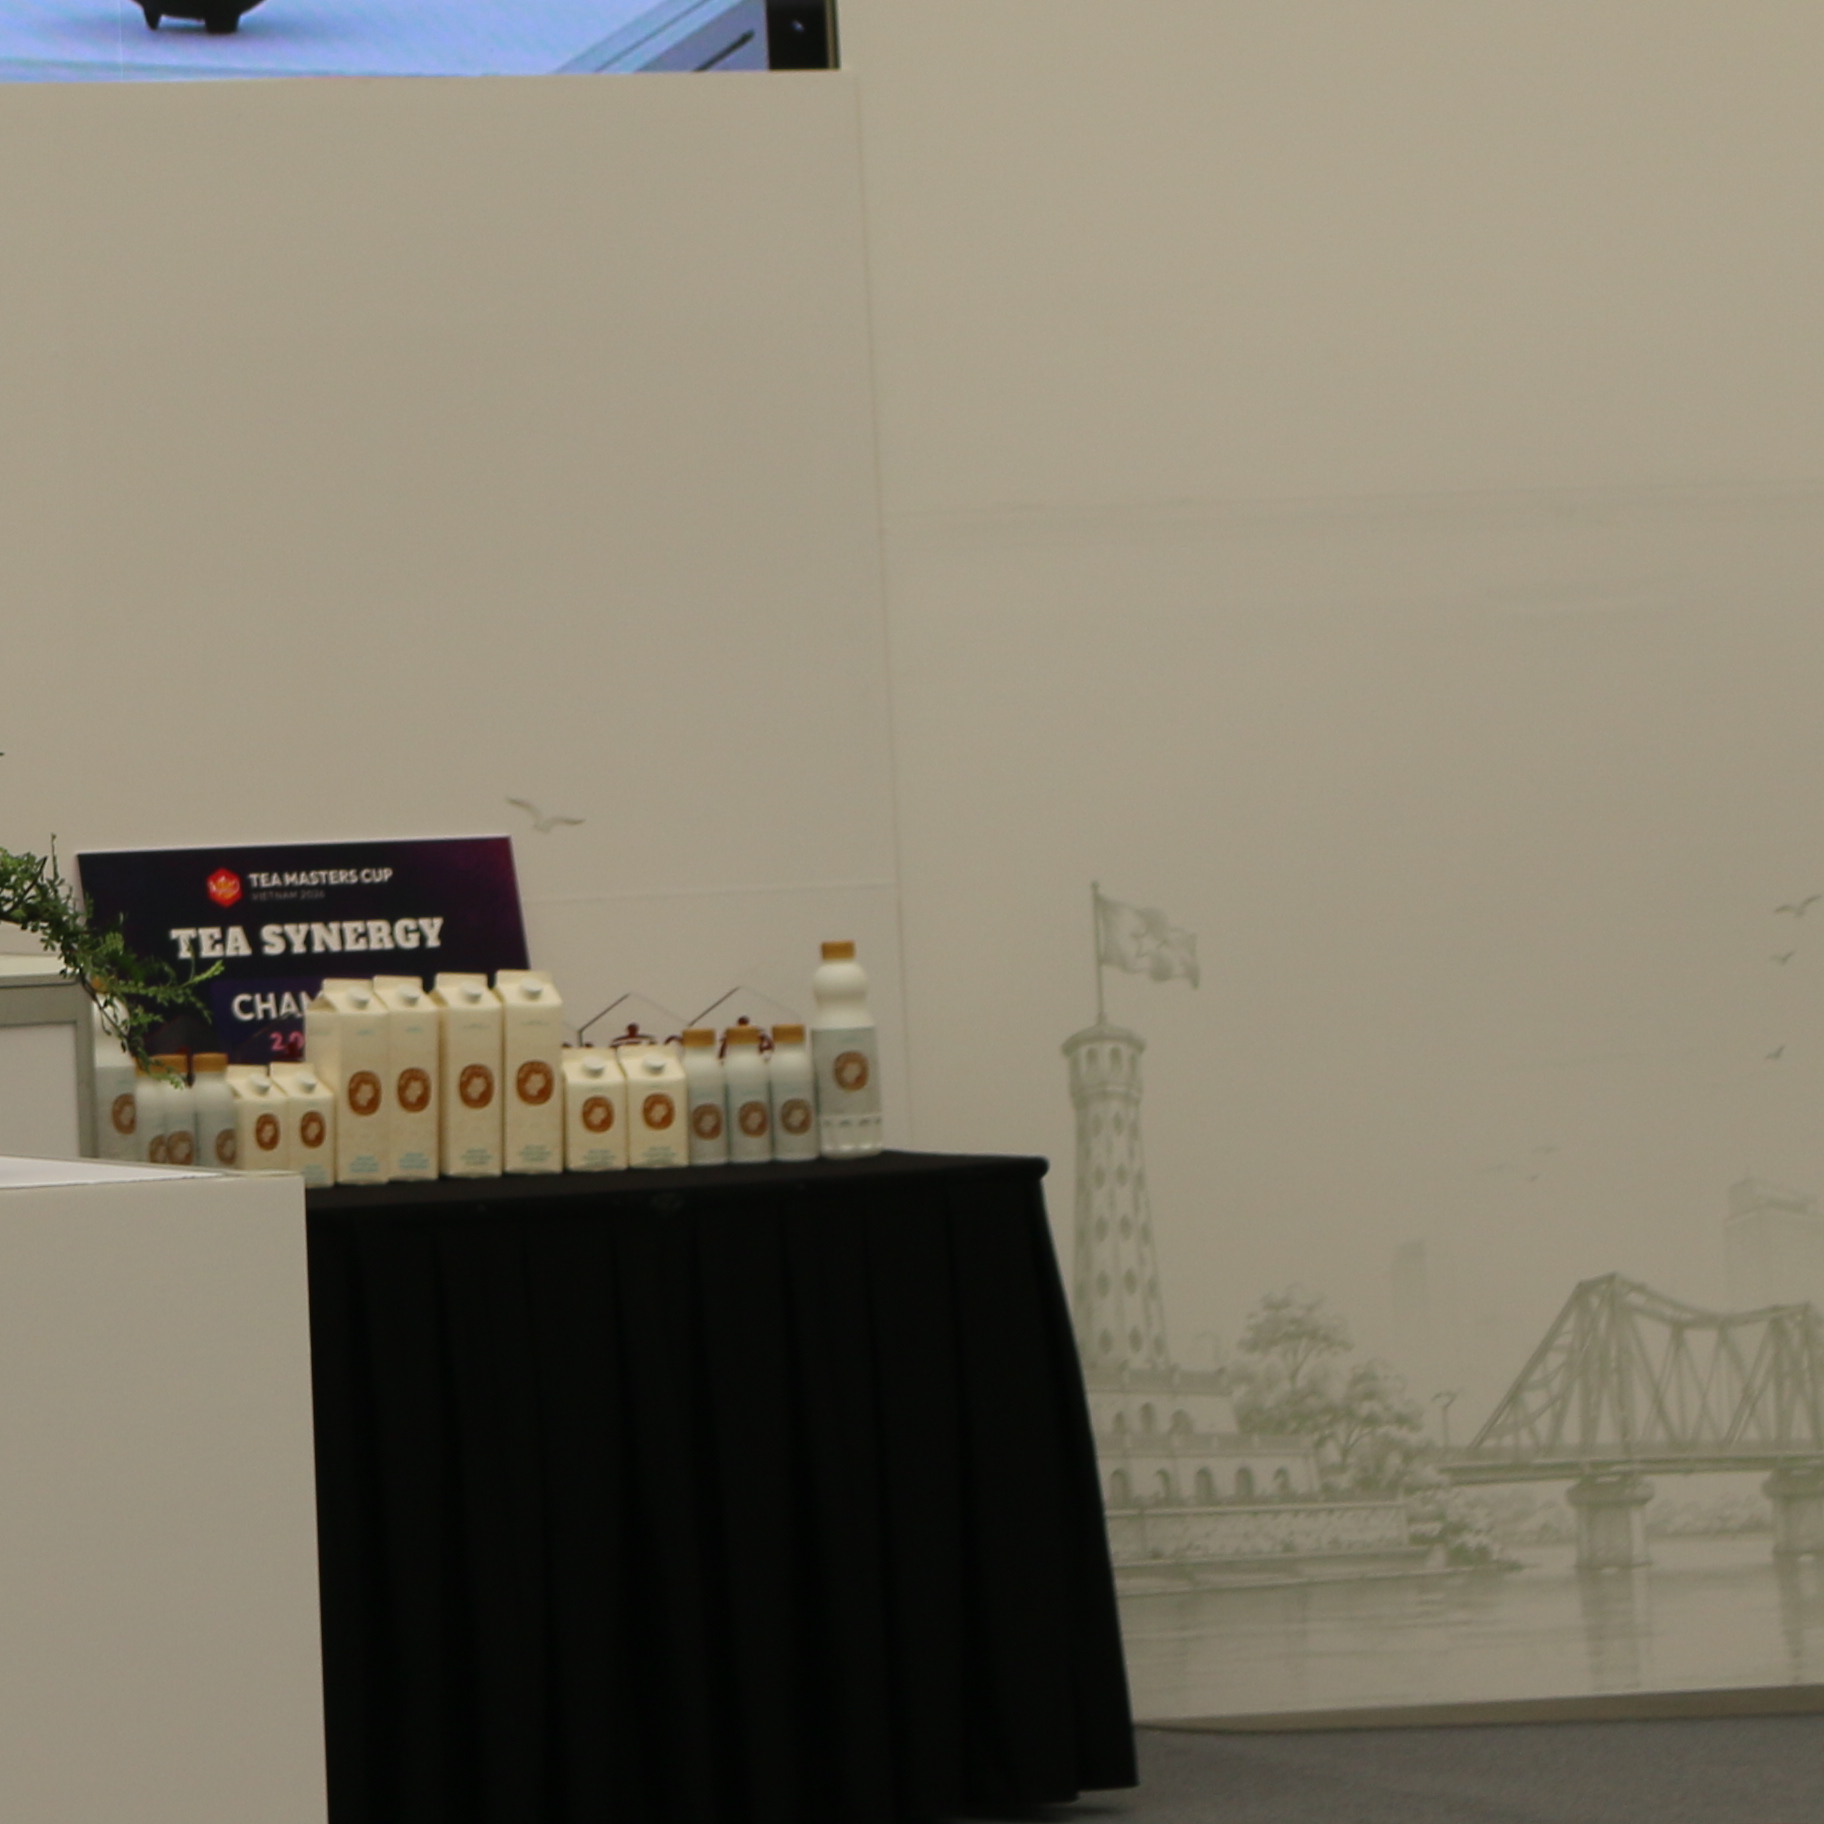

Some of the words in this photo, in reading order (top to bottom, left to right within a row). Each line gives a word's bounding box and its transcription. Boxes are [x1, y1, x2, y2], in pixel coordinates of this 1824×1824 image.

[250, 872, 282, 888] TEA
[284, 870, 359, 887] MASTERS
[361, 868, 393, 883] CUP
[170, 926, 252, 959] TEA
[260, 917, 444, 956] SYNERGY
